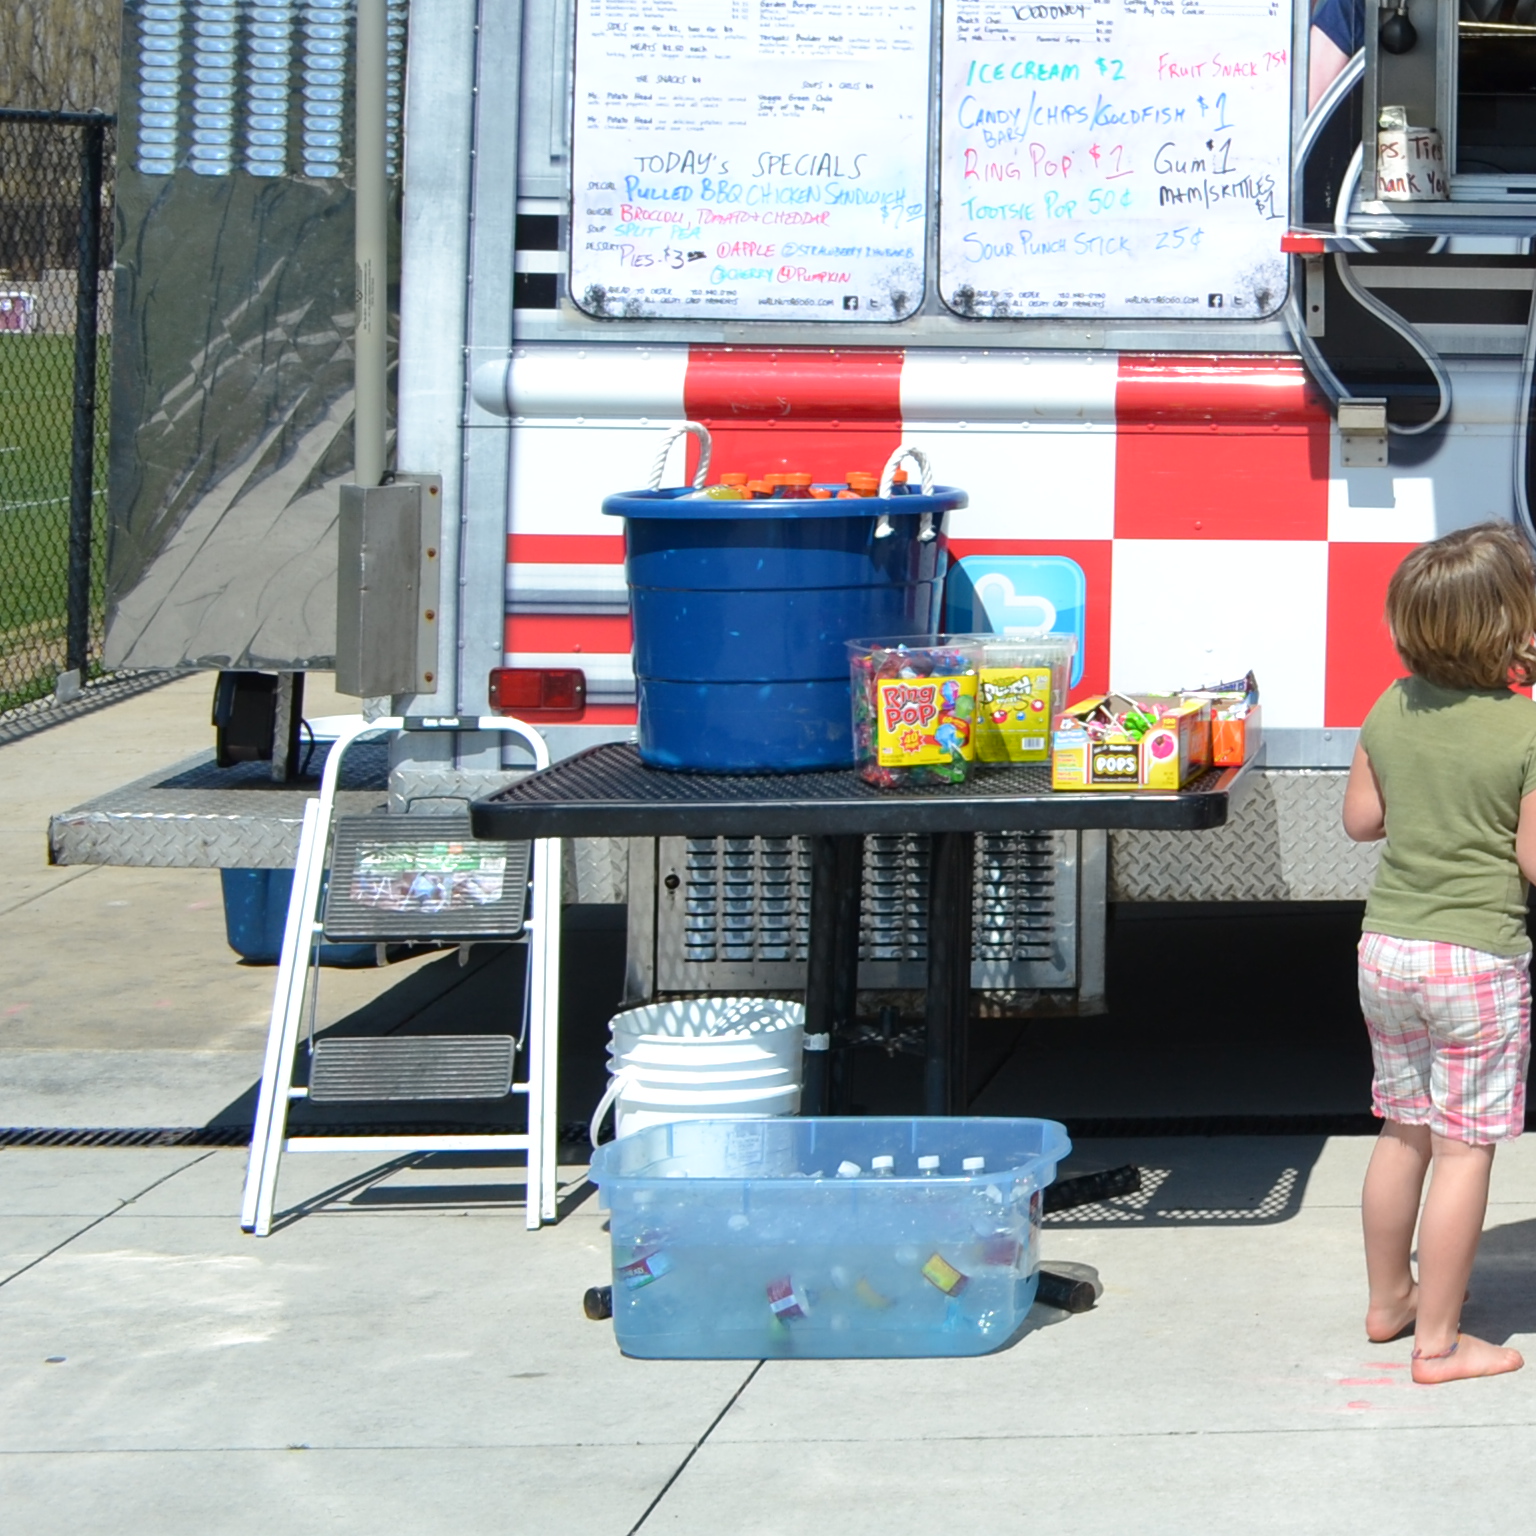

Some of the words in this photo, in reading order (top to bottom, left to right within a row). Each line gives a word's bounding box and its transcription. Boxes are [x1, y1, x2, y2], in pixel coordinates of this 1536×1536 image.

[966, 60, 1004, 86] ICE
[1010, 60, 1080, 81] CREAM
[1095, 56, 1127, 81] $2
[1158, 52, 1208, 81] FRUIT
[1212, 52, 1258, 78] SNACK
[1196, 92, 1235, 132] $1
[983, 128, 1026, 148] BARS
[752, 151, 868, 180] SPECIALS
[964, 148, 1021, 181] RING
[1029, 142, 1073, 178] POP
[1088, 143, 1134, 180] $1
[1206, 138, 1237, 174] $1
[624, 174, 693, 202] PULLED
[701, 177, 743, 204] BBQ
[746, 182, 821, 206] CHICKEN
[824, 181, 906, 206] SANDWICH
[961, 196, 1035, 221] TOOTSIE
[1044, 189, 1078, 219] POP
[1255, 191, 1286, 221] $1
[614, 222, 663, 237] SPLIT
[670, 226, 701, 240] PEA
[962, 231, 1016, 262] SOUR
[1019, 230, 1067, 257] PUNCH
[1073, 231, 1131, 256] STICK
[619, 243, 655, 267] PIES
[731, 242, 776, 259] APPLE
[882, 683, 936, 709] Ring
[1094, 754, 1138, 774] POPS
